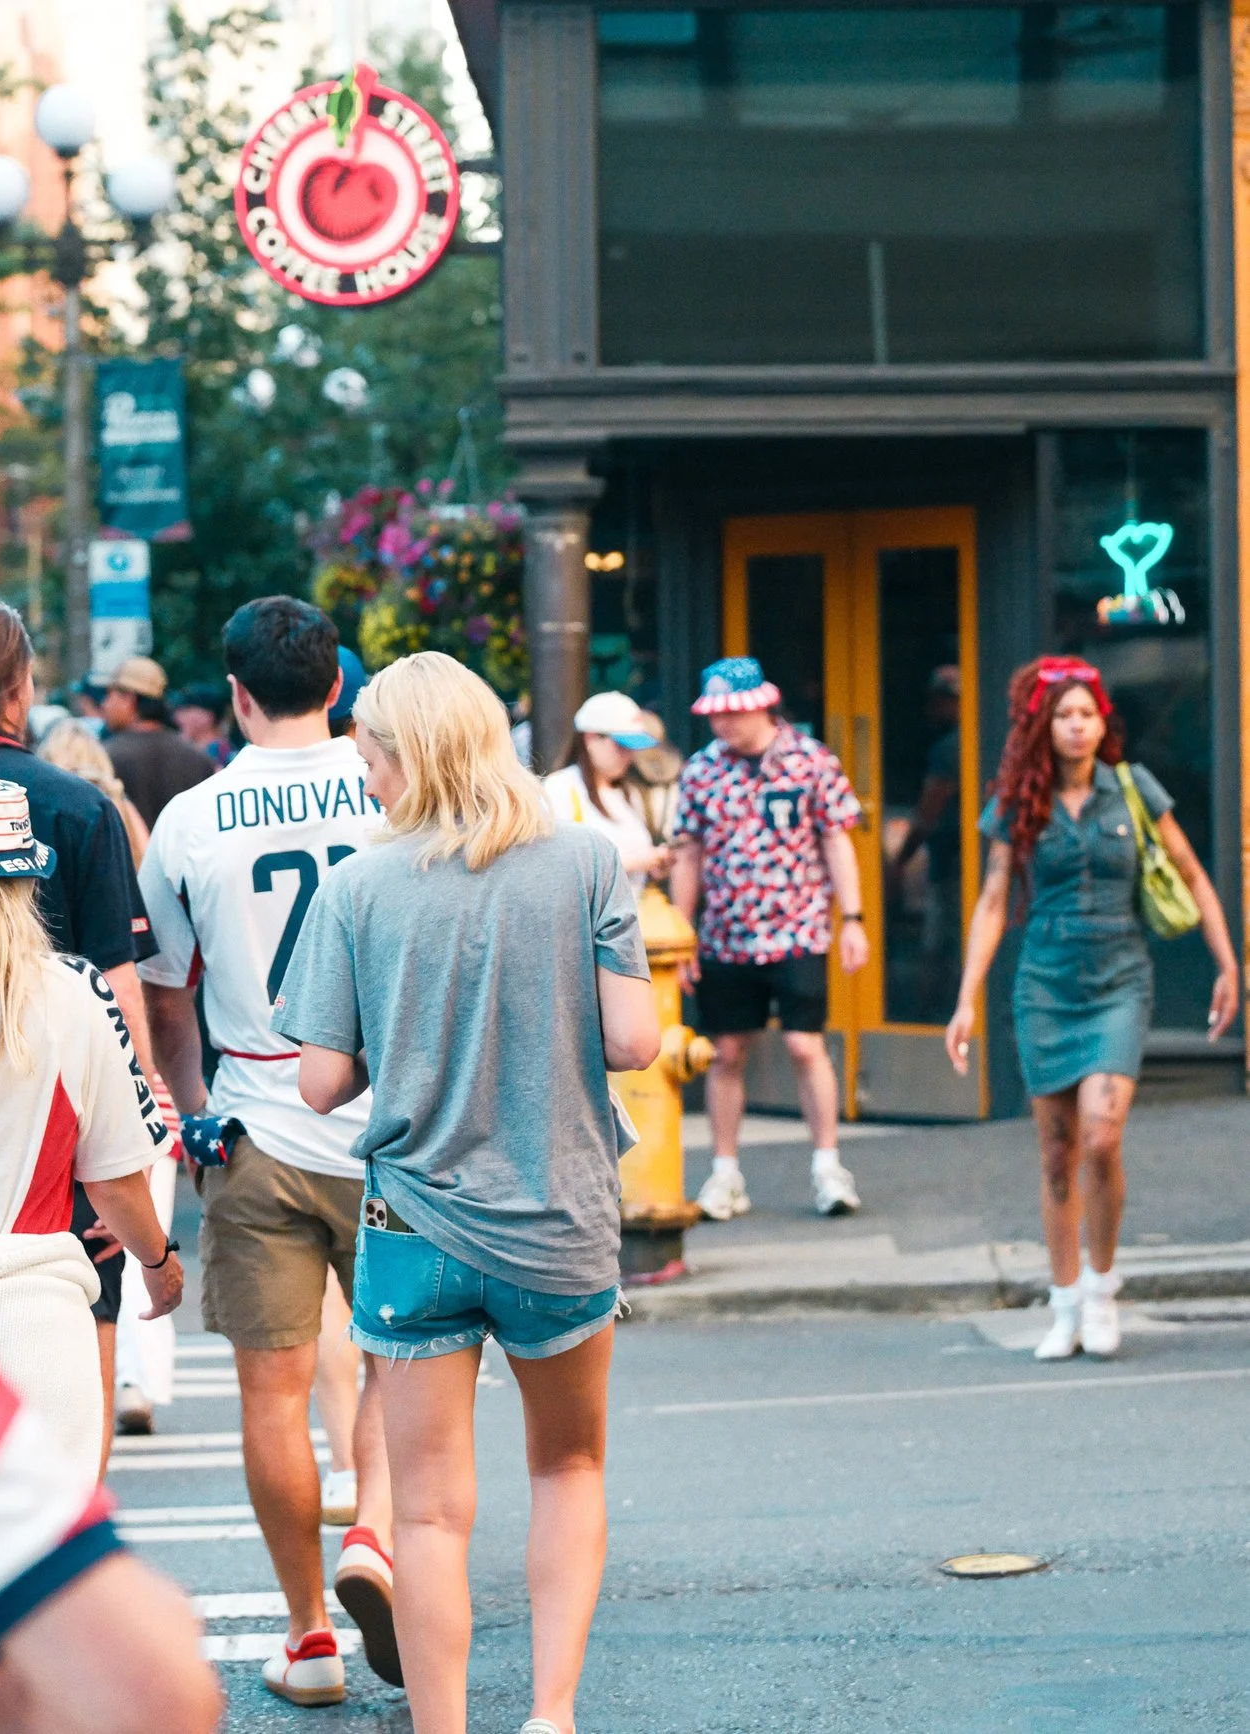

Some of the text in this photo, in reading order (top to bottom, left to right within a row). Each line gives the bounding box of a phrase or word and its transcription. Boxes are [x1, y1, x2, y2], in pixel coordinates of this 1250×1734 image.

[242, 94, 452, 193] CHERRY STREET
[246, 206, 449, 297] COFFEE HOUSE
